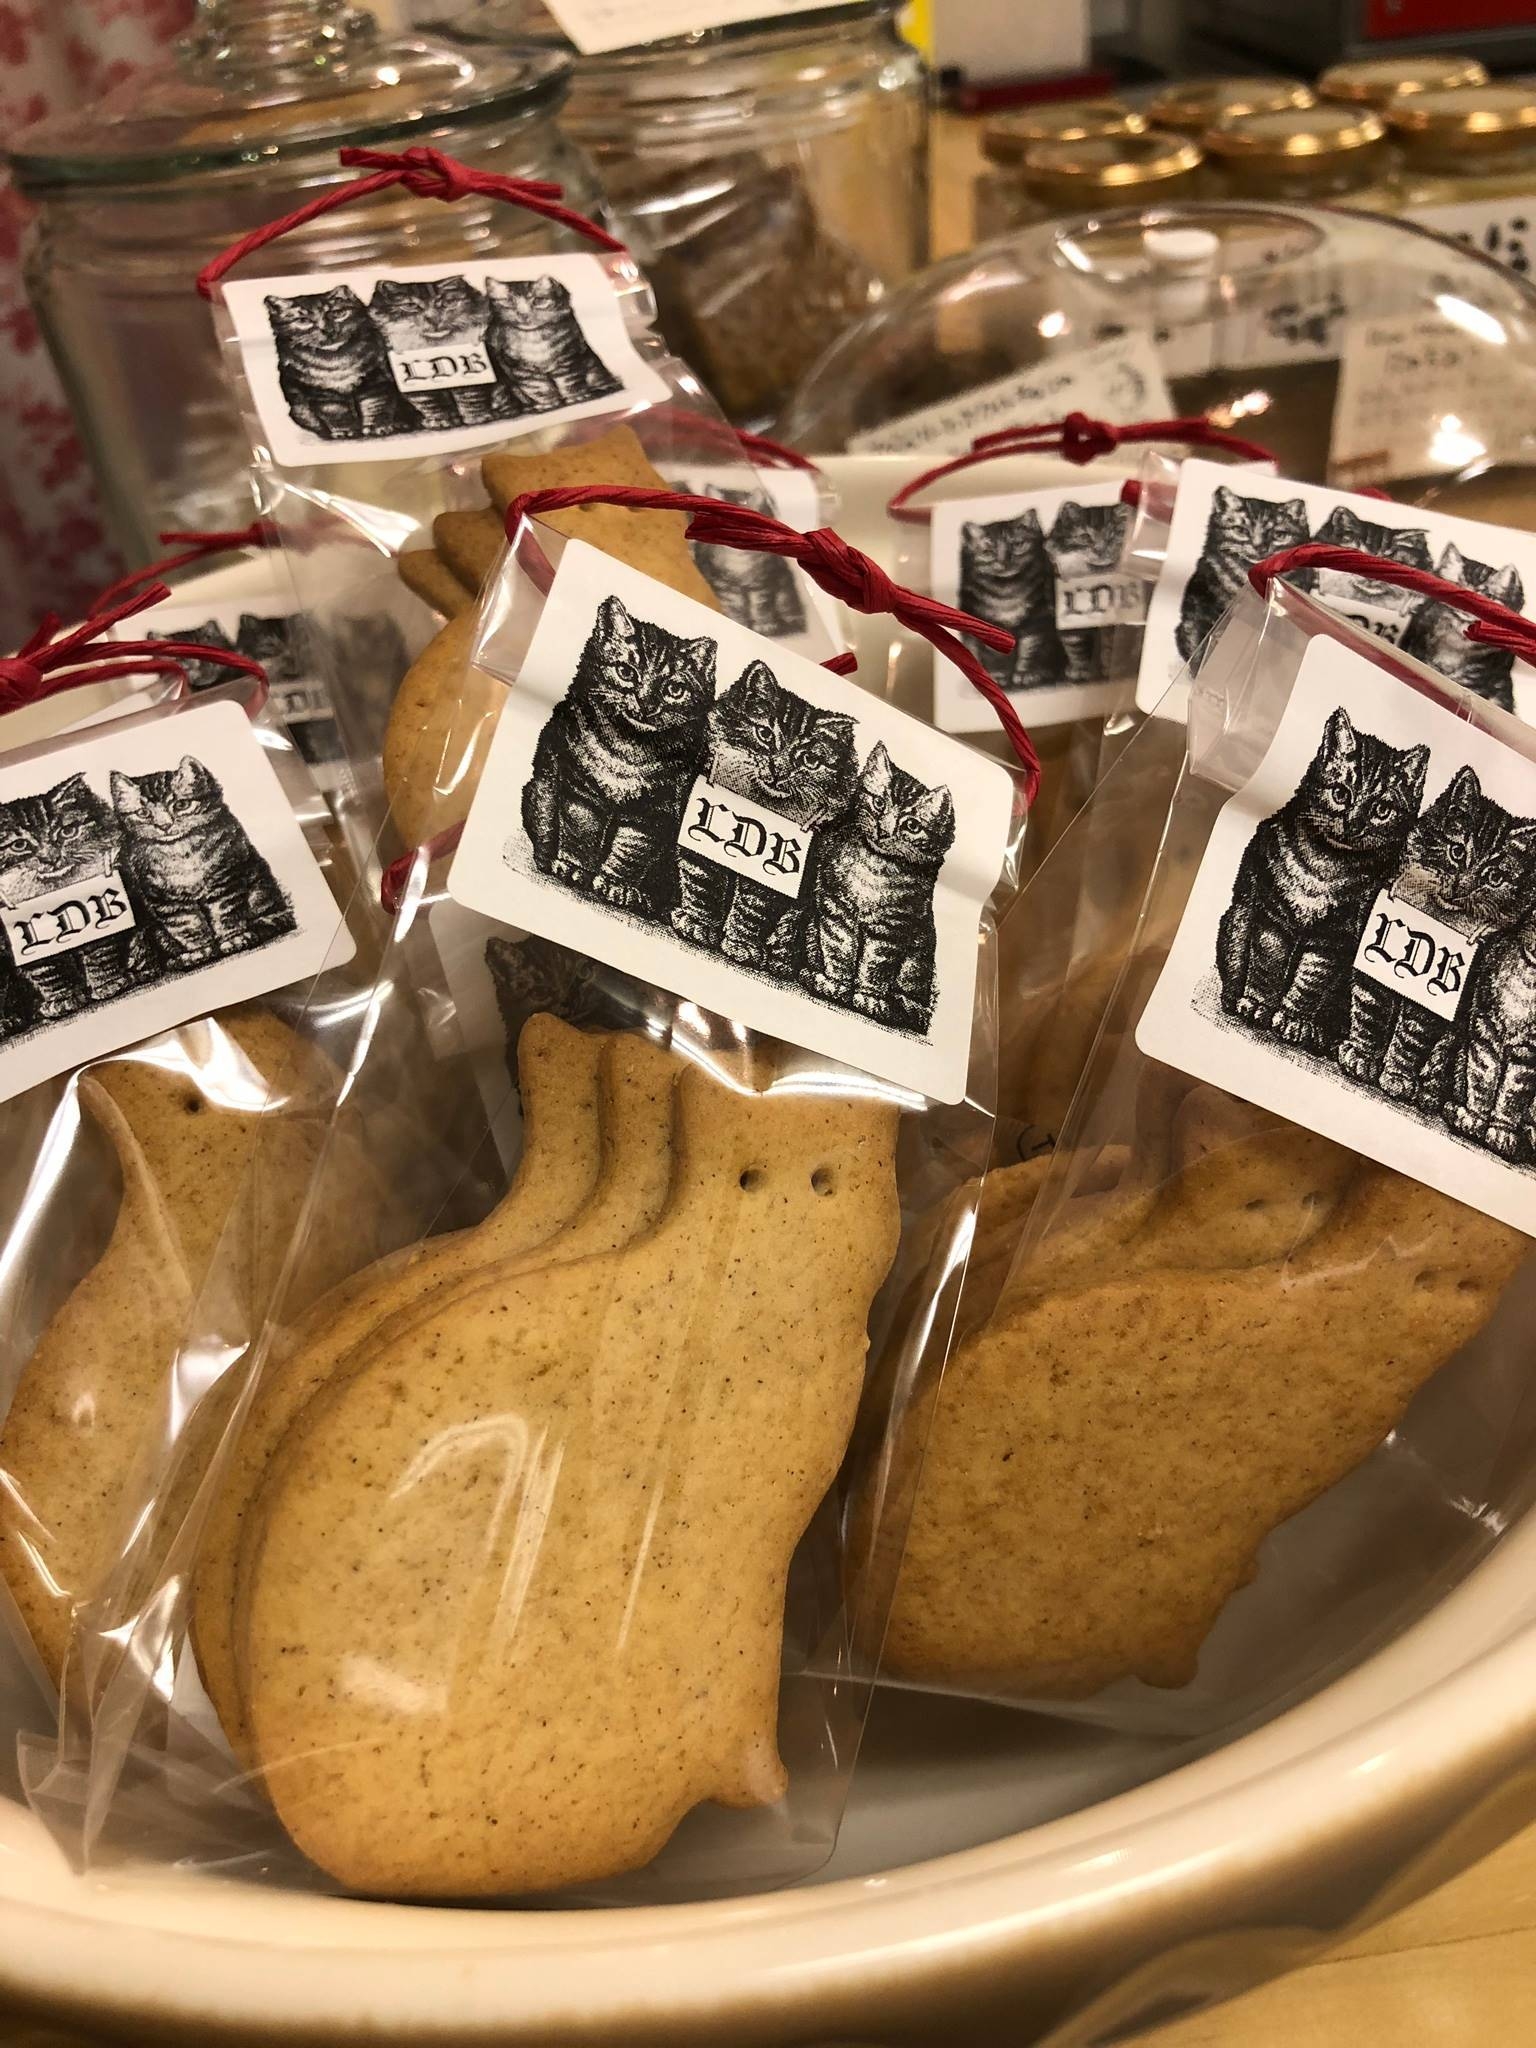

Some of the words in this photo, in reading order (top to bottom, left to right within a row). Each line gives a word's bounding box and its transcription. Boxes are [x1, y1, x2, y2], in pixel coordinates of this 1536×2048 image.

[400, 353, 487, 382] LDB
[687, 797, 802, 876] LDB
[13, 888, 128, 955] LDB
[1364, 912, 1466, 996] LDB
